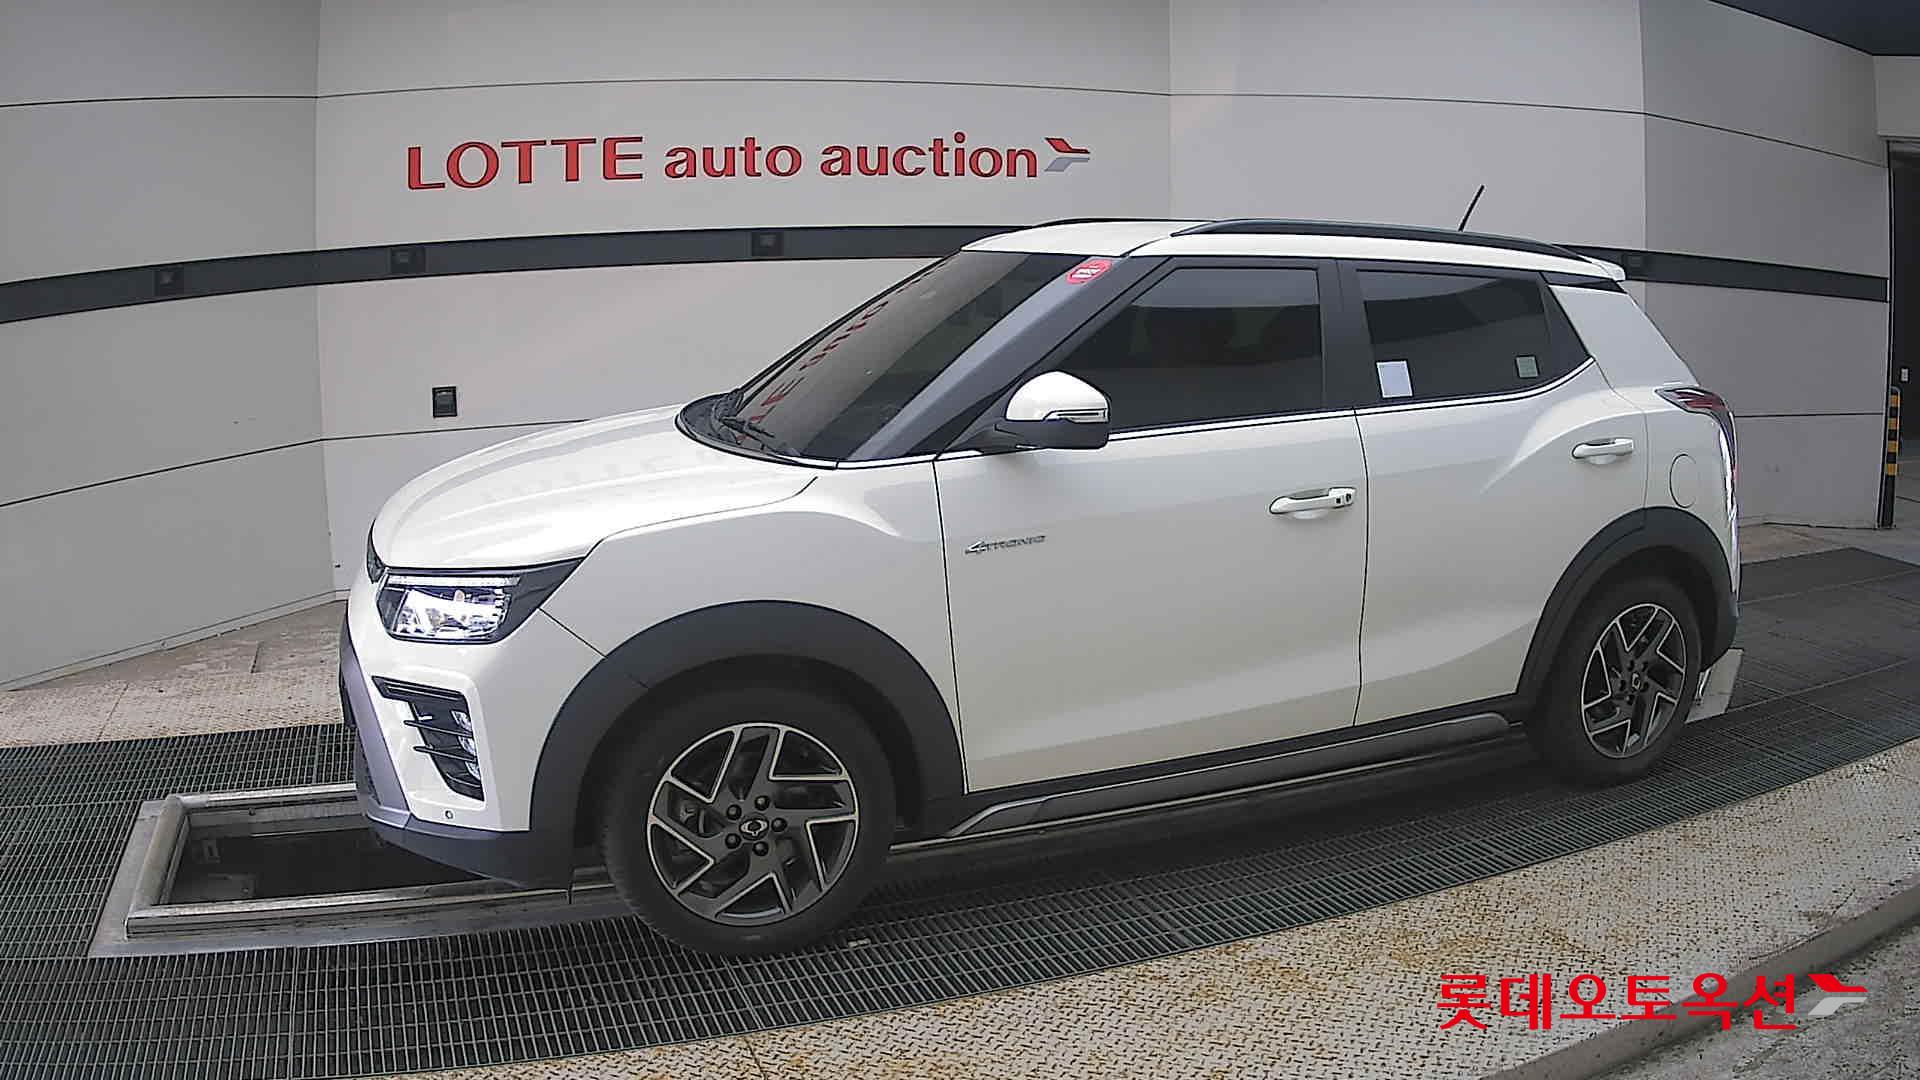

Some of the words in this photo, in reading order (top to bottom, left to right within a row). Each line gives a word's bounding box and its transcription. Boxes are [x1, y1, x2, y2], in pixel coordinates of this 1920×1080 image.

[406, 137, 644, 190] LOTTE
[664, 137, 802, 179] auto
[820, 132, 1039, 179] auction
